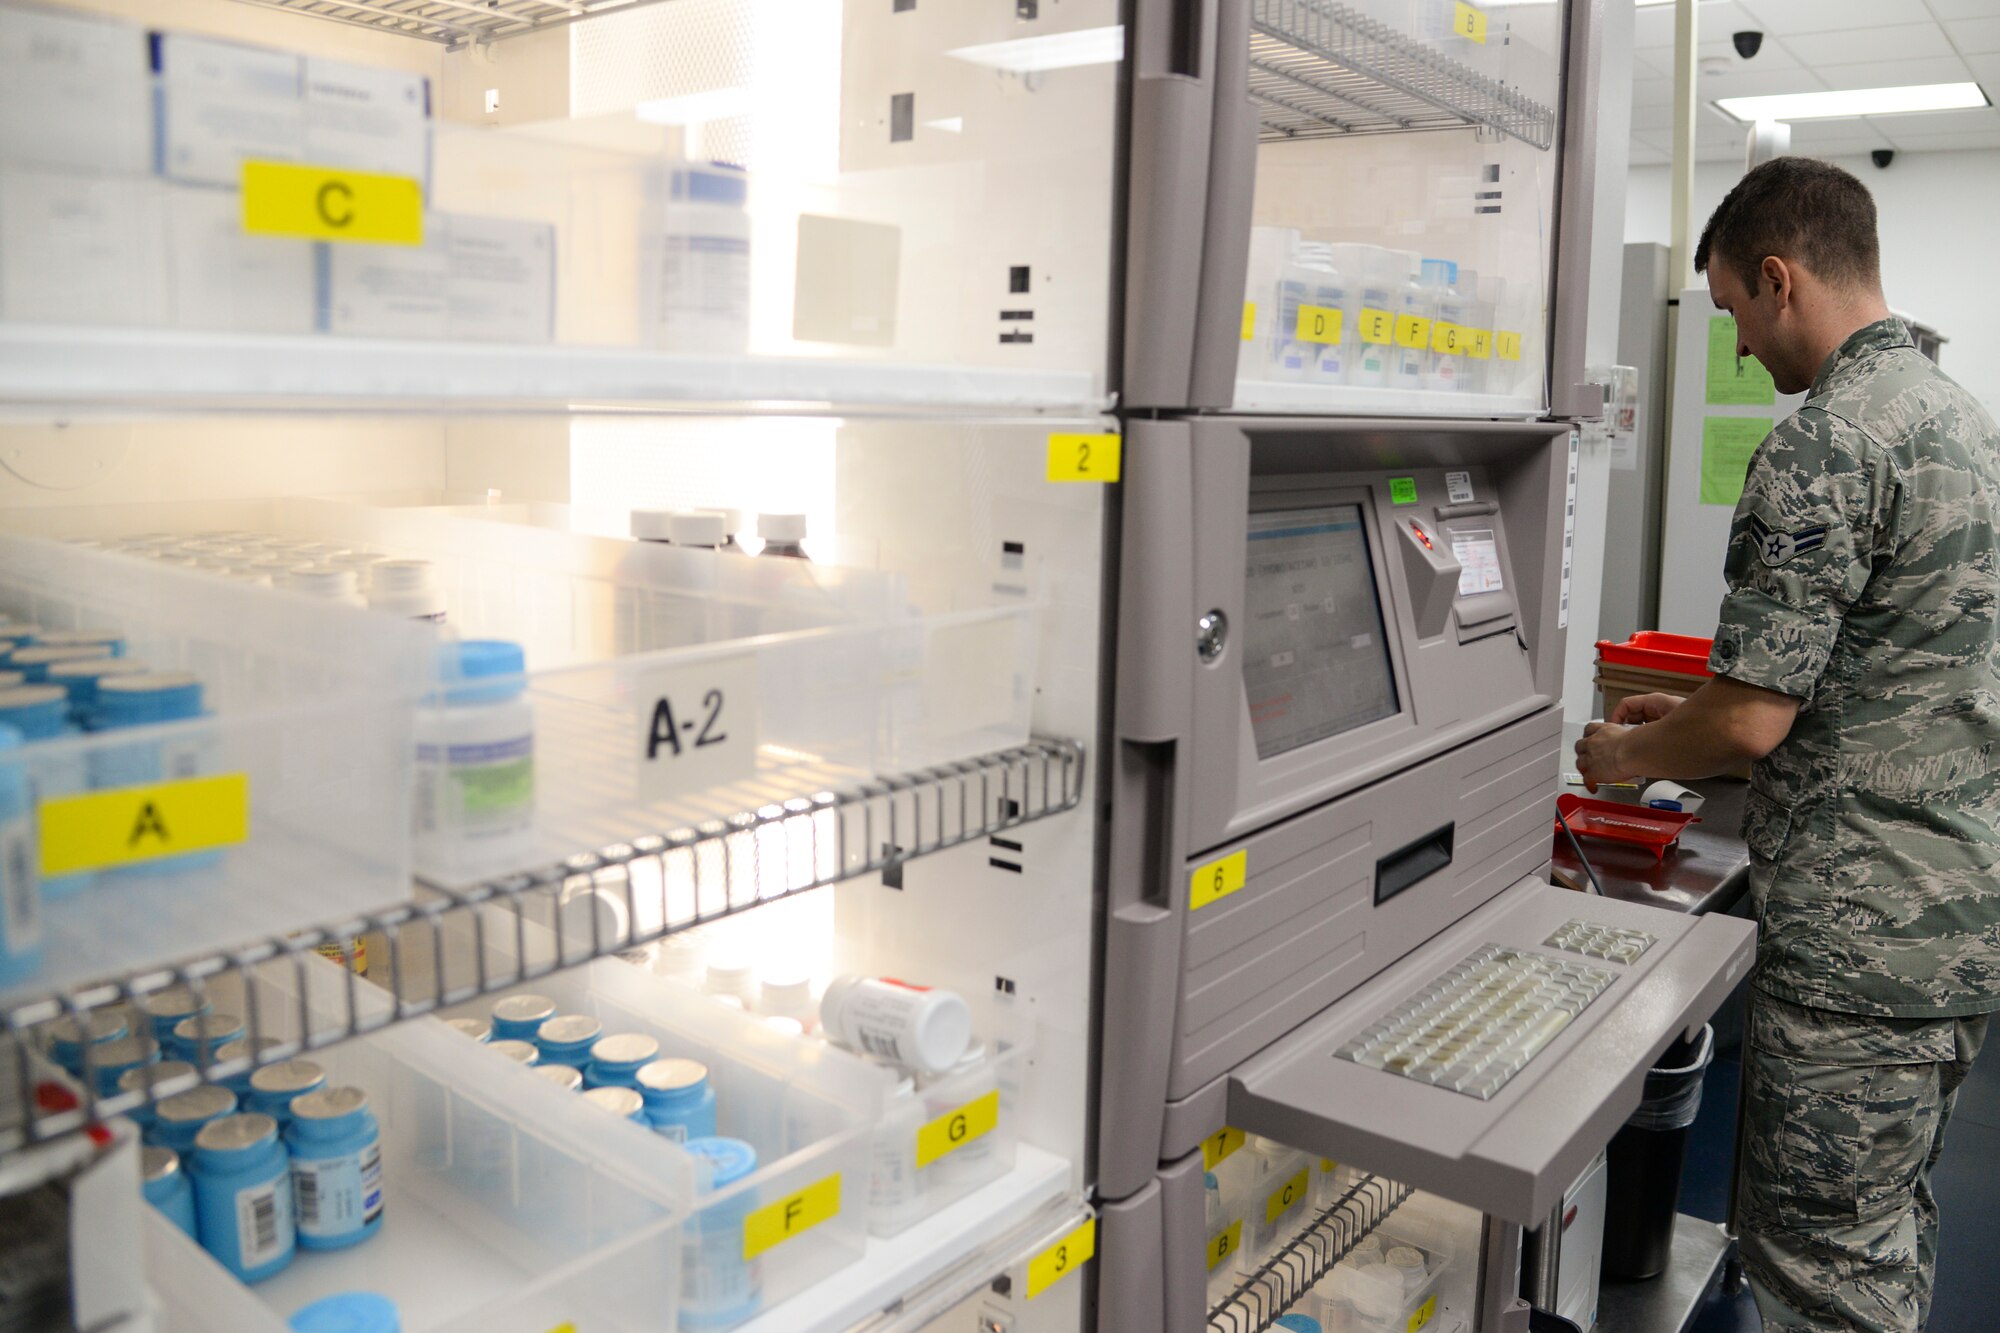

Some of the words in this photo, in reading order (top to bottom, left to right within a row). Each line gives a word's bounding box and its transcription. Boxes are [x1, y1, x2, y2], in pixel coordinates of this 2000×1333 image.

[1466, 13, 1474, 34] B
[315, 180, 354, 229] C
[1314, 314, 1325, 336] D
[1373, 316, 1383, 337] E
[1411, 322, 1419, 341] F
[1447, 329, 1456, 349] G
[1475, 335, 1483, 352] H
[1077, 443, 1090, 473] 2
[646, 689, 726, 760] A-2
[128, 801, 169, 846] A
[1213, 866, 1224, 892] 6
[948, 1114, 967, 1143] G
[1217, 1131, 1228, 1156] 7
[1282, 1184, 1293, 1206] C
[785, 1199, 802, 1231] F
[1217, 1236, 1229, 1257] B
[1055, 1246, 1068, 1273] 3
[1417, 1308, 1425, 1325] J
